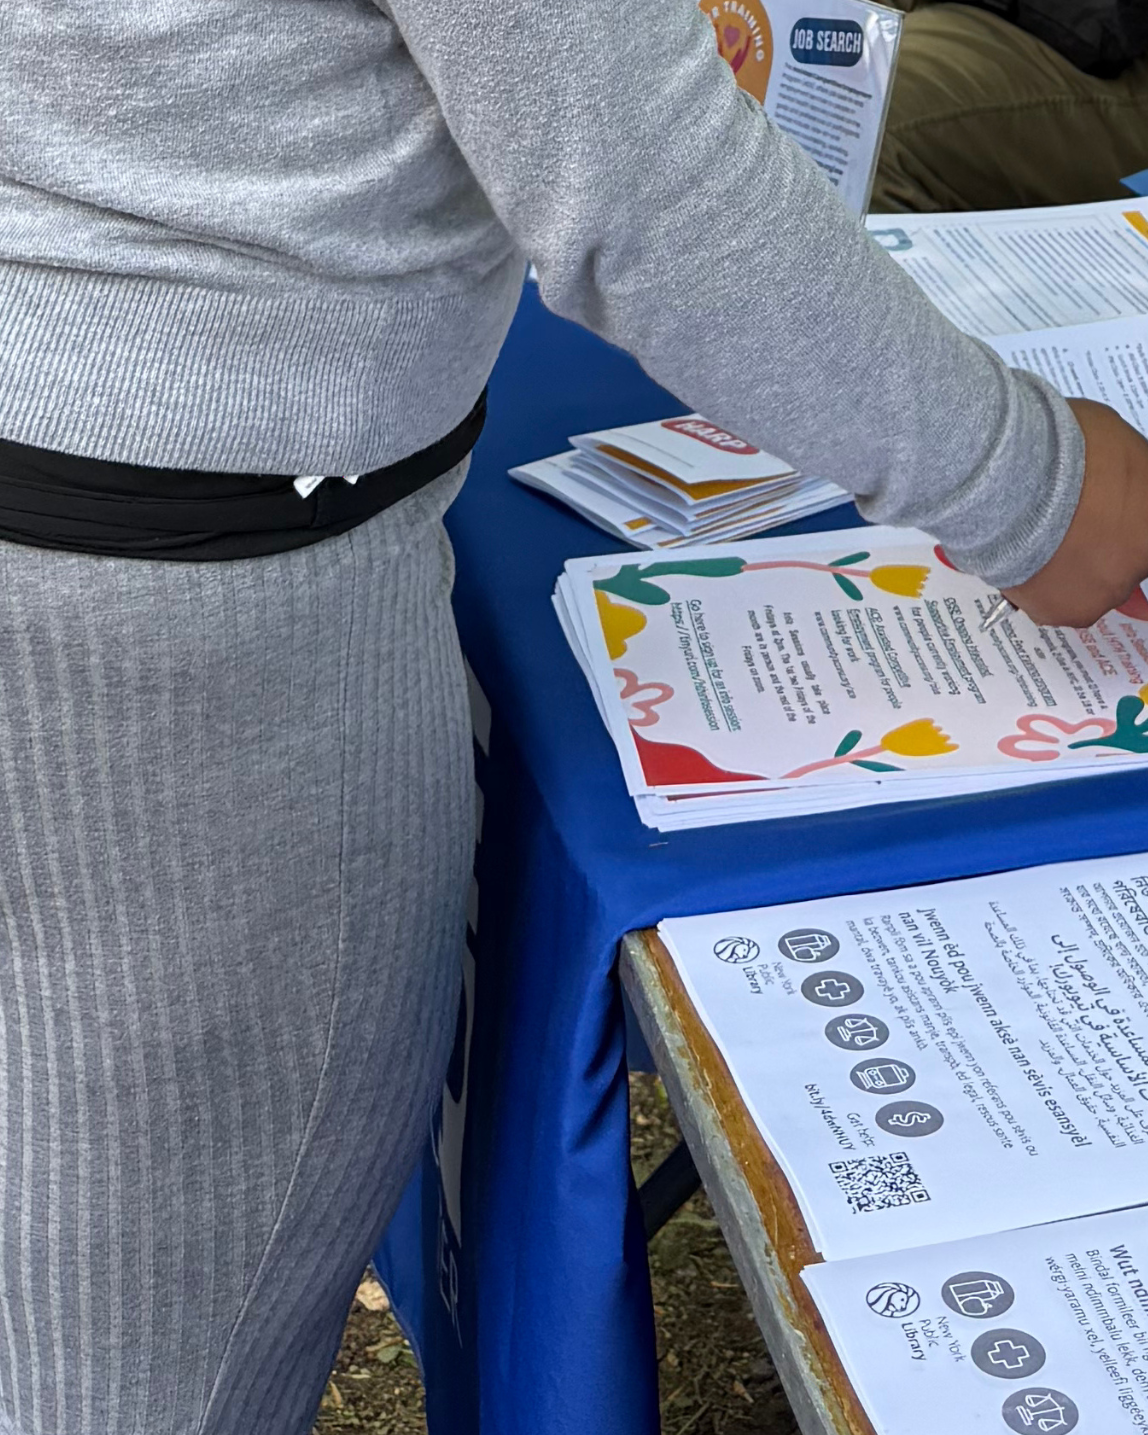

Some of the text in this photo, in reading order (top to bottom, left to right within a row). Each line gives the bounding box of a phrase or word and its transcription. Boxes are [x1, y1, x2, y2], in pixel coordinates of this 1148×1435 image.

[723, 0, 765, 62] TRAINING
[792, 28, 862, 54] JOB SEARCH
[674, 421, 748, 449] HARP
[897, 911, 960, 995] nan vil Nouyòk
[1050, 933, 1080, 955] إلى
[1048, 962, 1096, 1012] نيويورك!
[1063, 954, 1112, 997] الوصول
[1079, 1014, 1111, 1032] في
[1094, 997, 1126, 1016] في
[915, 907, 1094, 1148] Jwenn èd pou jwenn aksè nan sèvis esansyèl
[1109, 1243, 1140, 1278] Wut
[900, 1321, 927, 1361] Library
